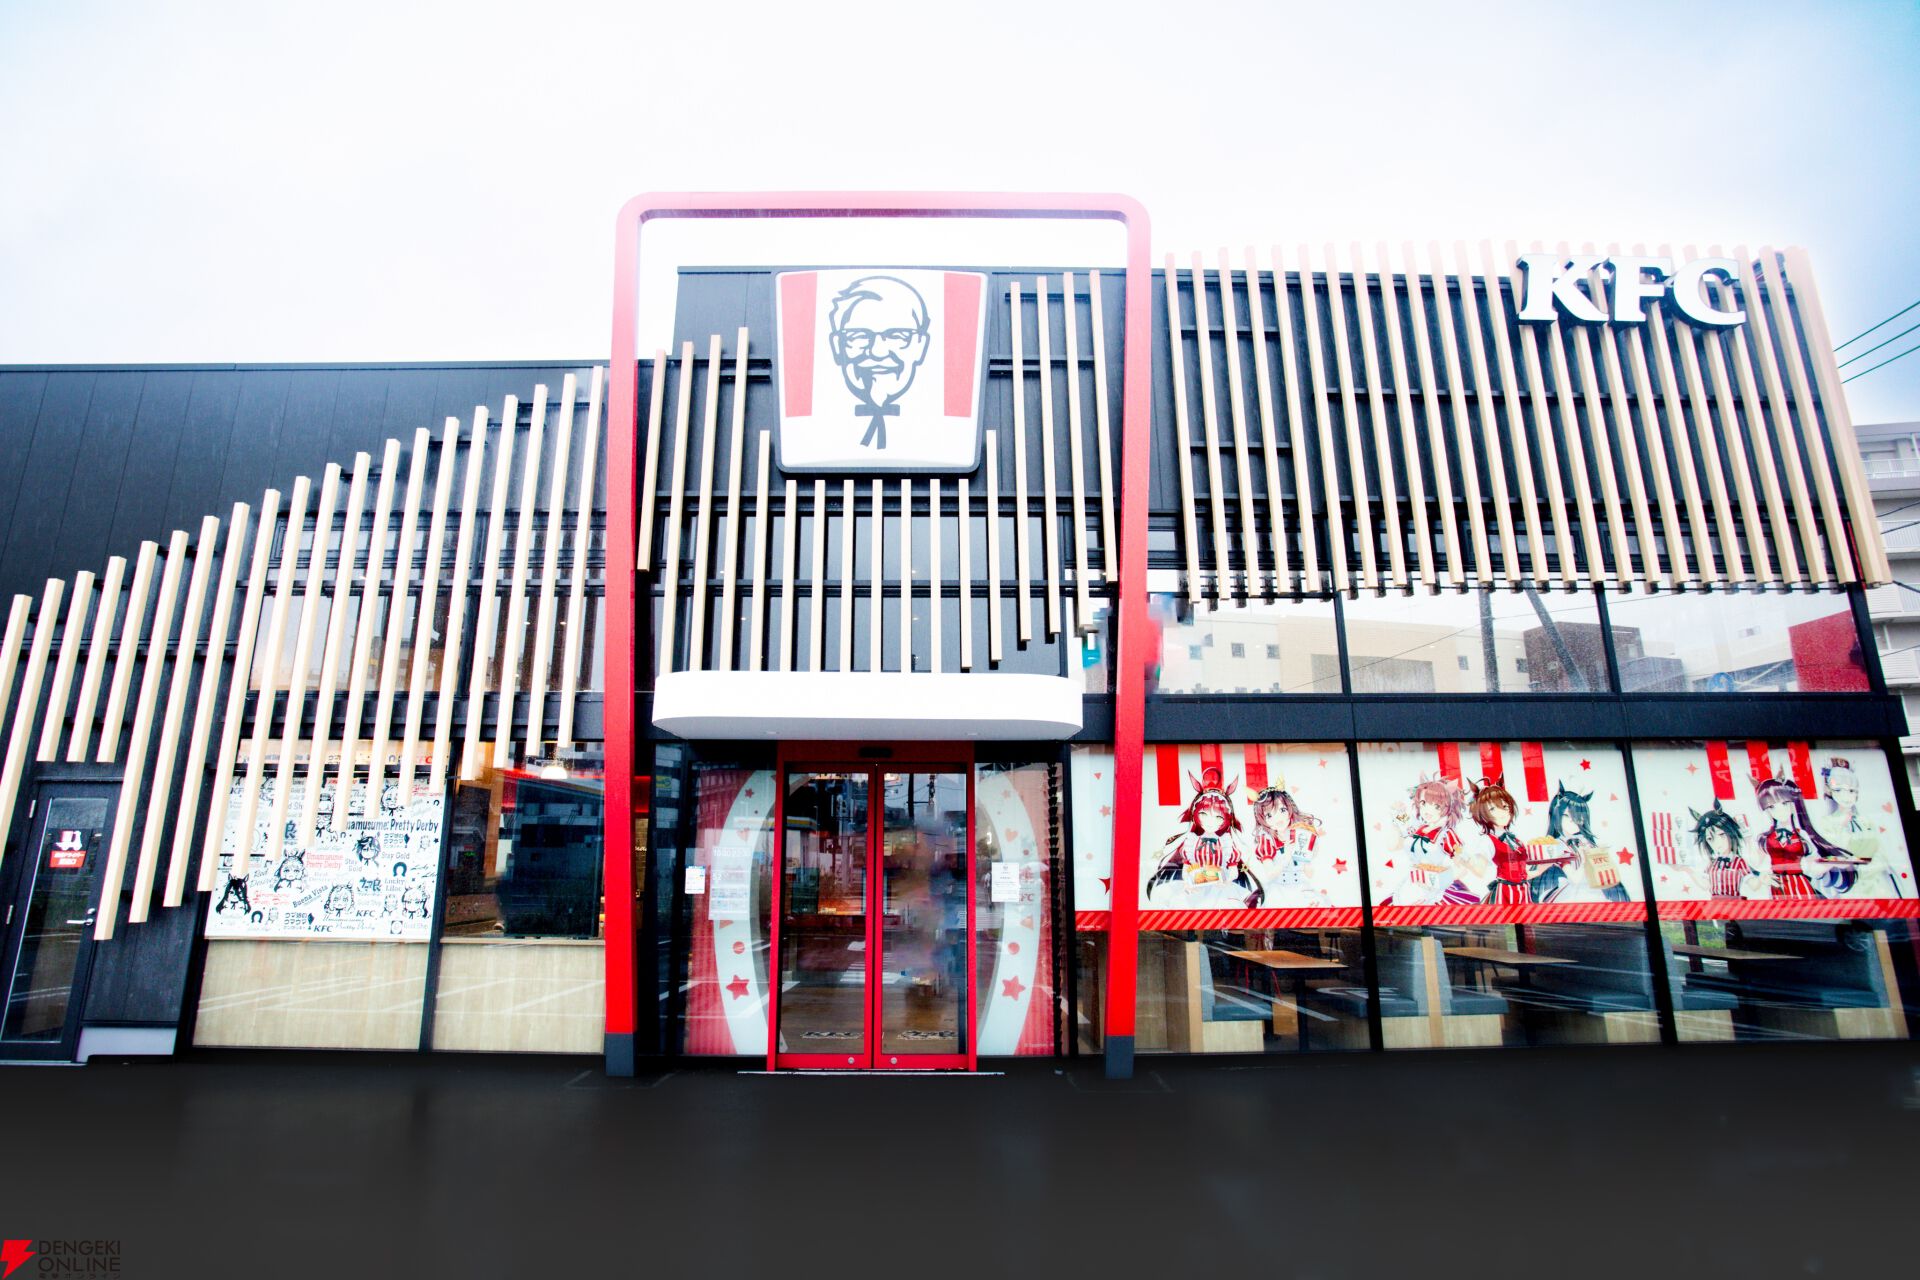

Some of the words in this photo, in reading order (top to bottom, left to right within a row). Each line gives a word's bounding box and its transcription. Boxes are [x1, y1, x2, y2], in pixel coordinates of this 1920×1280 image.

[1516, 253, 1747, 327] KFC
[390, 819, 415, 833] Pretty
[416, 819, 439, 834] Derby
[395, 851, 410, 860] Gold
[292, 894, 313, 909] Buena
[311, 885, 329, 897] Vista
[356, 909, 376, 917] KFC
[313, 925, 333, 933] KFC
